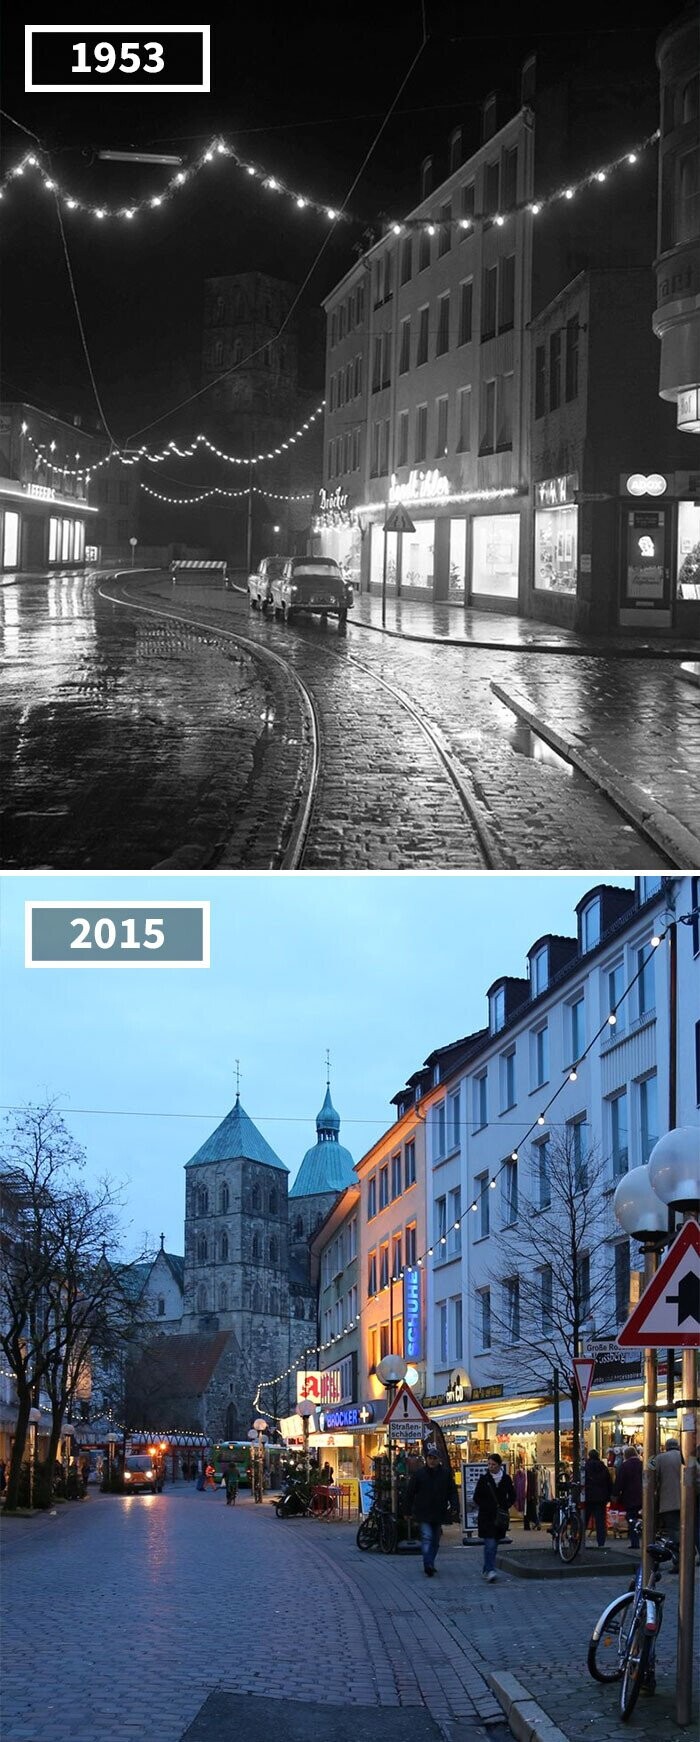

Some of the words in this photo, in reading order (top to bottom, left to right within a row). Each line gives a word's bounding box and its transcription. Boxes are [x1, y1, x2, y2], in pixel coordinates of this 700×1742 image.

[630, 480, 663, 491] ADOX
[407, 1271, 419, 1357] SCHUHE
[586, 1344, 607, 1352] Große
[391, 1422, 421, 1431] Straßen-
[391, 1430, 422, 1438] schäden
